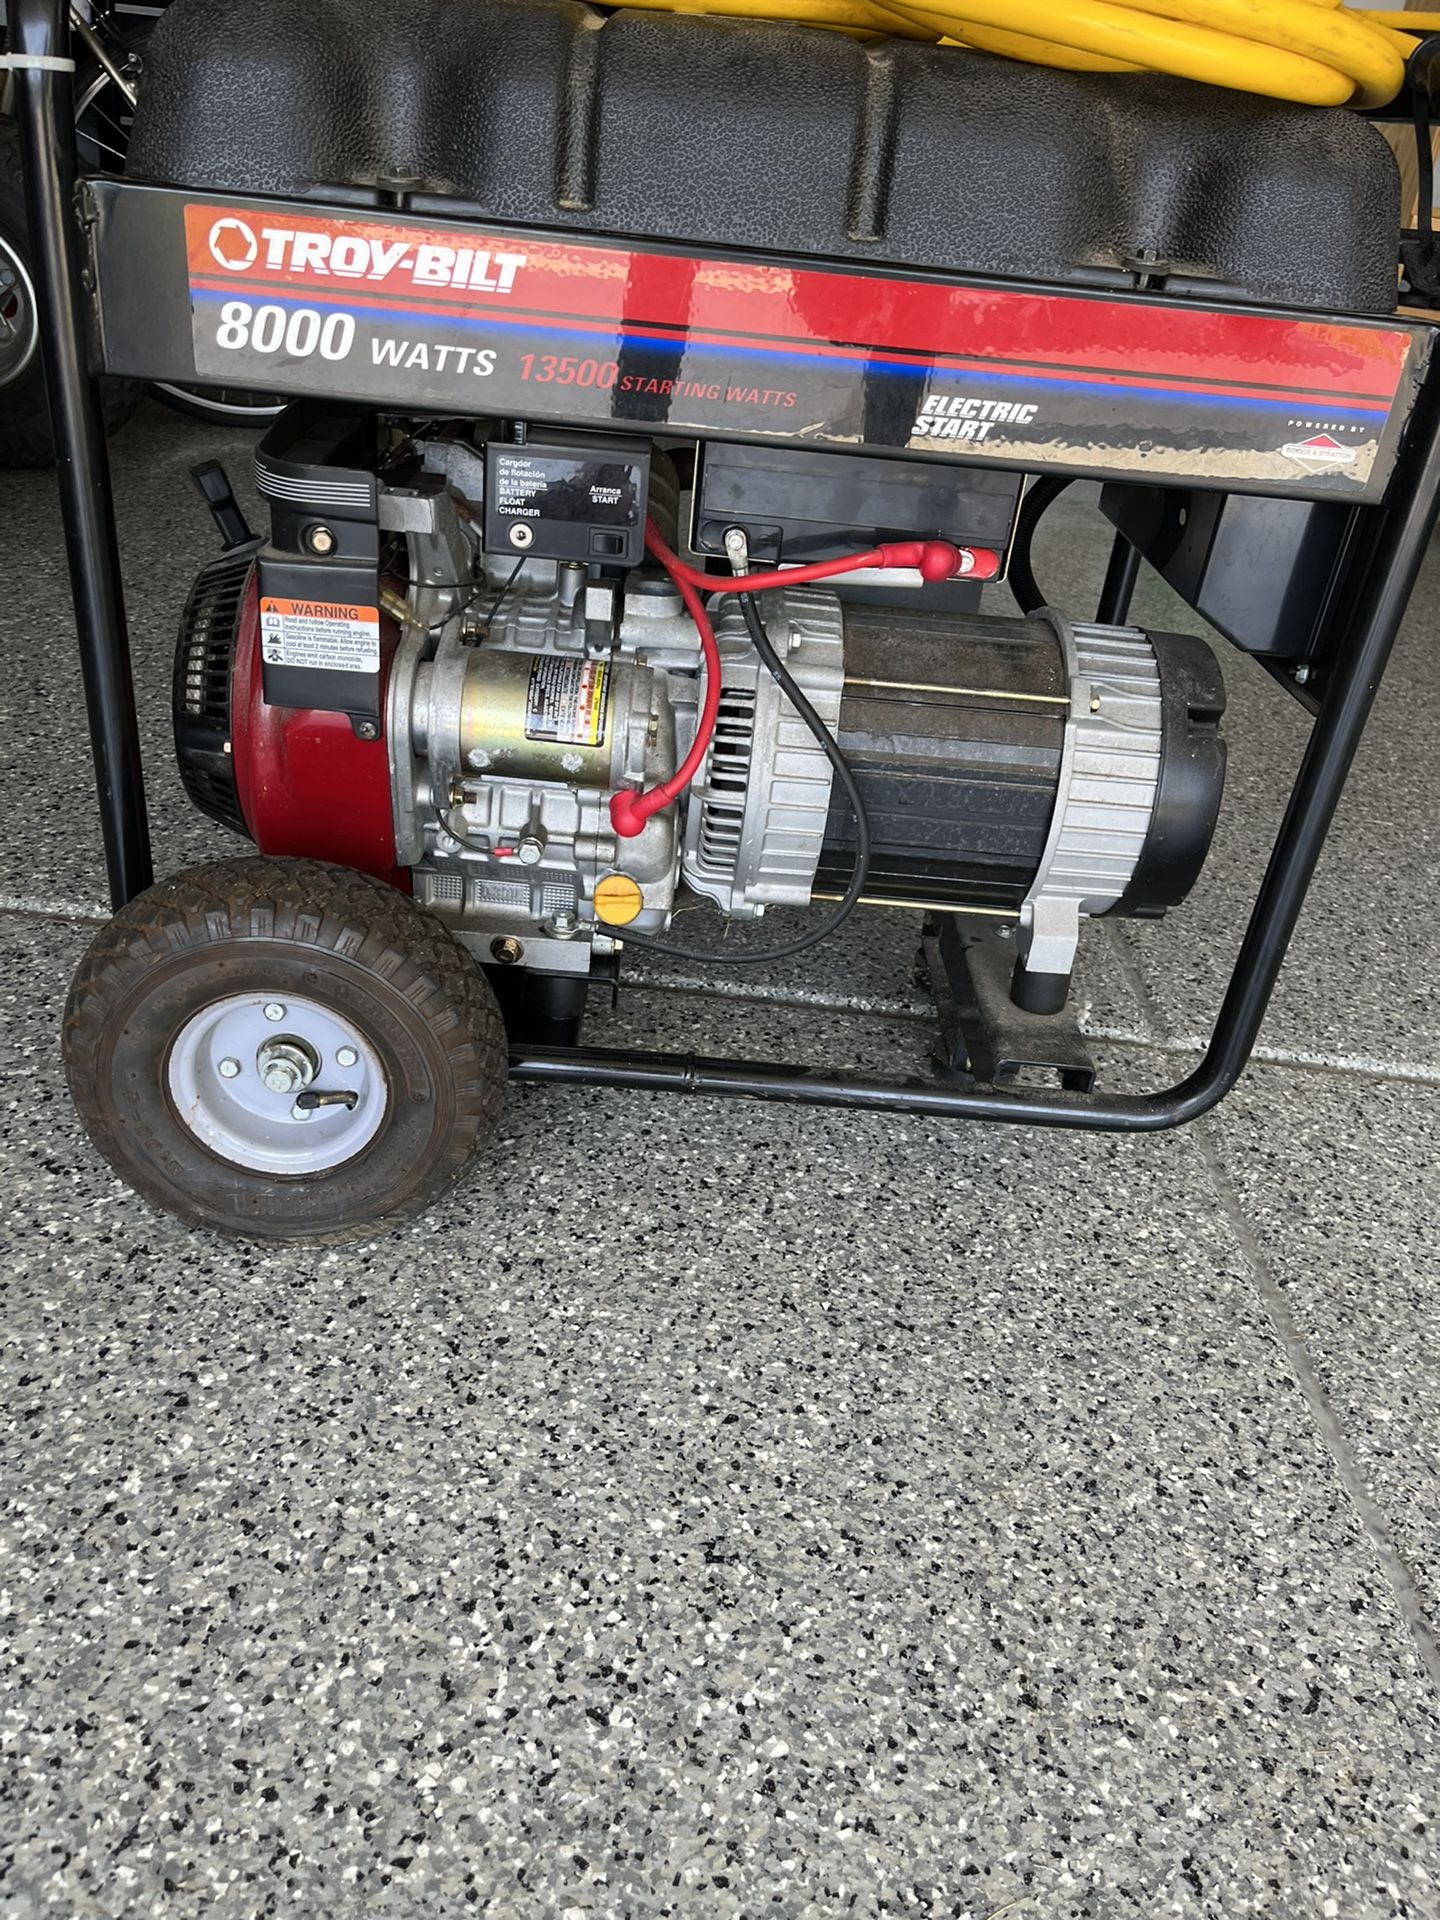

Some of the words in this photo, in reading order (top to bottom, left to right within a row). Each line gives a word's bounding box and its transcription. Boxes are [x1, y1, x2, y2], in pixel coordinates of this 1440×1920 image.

[261, 227, 528, 293] TROY-BILT
[216, 301, 356, 361] 8000
[371, 338, 498, 377] WATTS
[519, 353, 619, 389] 13500
[620, 375, 721, 400] STARTING
[725, 386, 798, 408] WATTS
[921, 394, 1039, 424] ELECTRIC
[911, 415, 996, 441] START
[1287, 420, 1346, 432] POWERED
[499, 468, 510, 476] de
[511, 468, 546, 479] flotación
[499, 477, 510, 486] de
[510, 478, 519, 487] la
[499, 487, 537, 498] BATTERY
[590, 485, 622, 495] Arranca
[499, 497, 526, 507] FLOAT
[592, 495, 619, 505] START
[499, 506, 541, 517] CHARGER
[290, 602, 359, 620] WARNING
